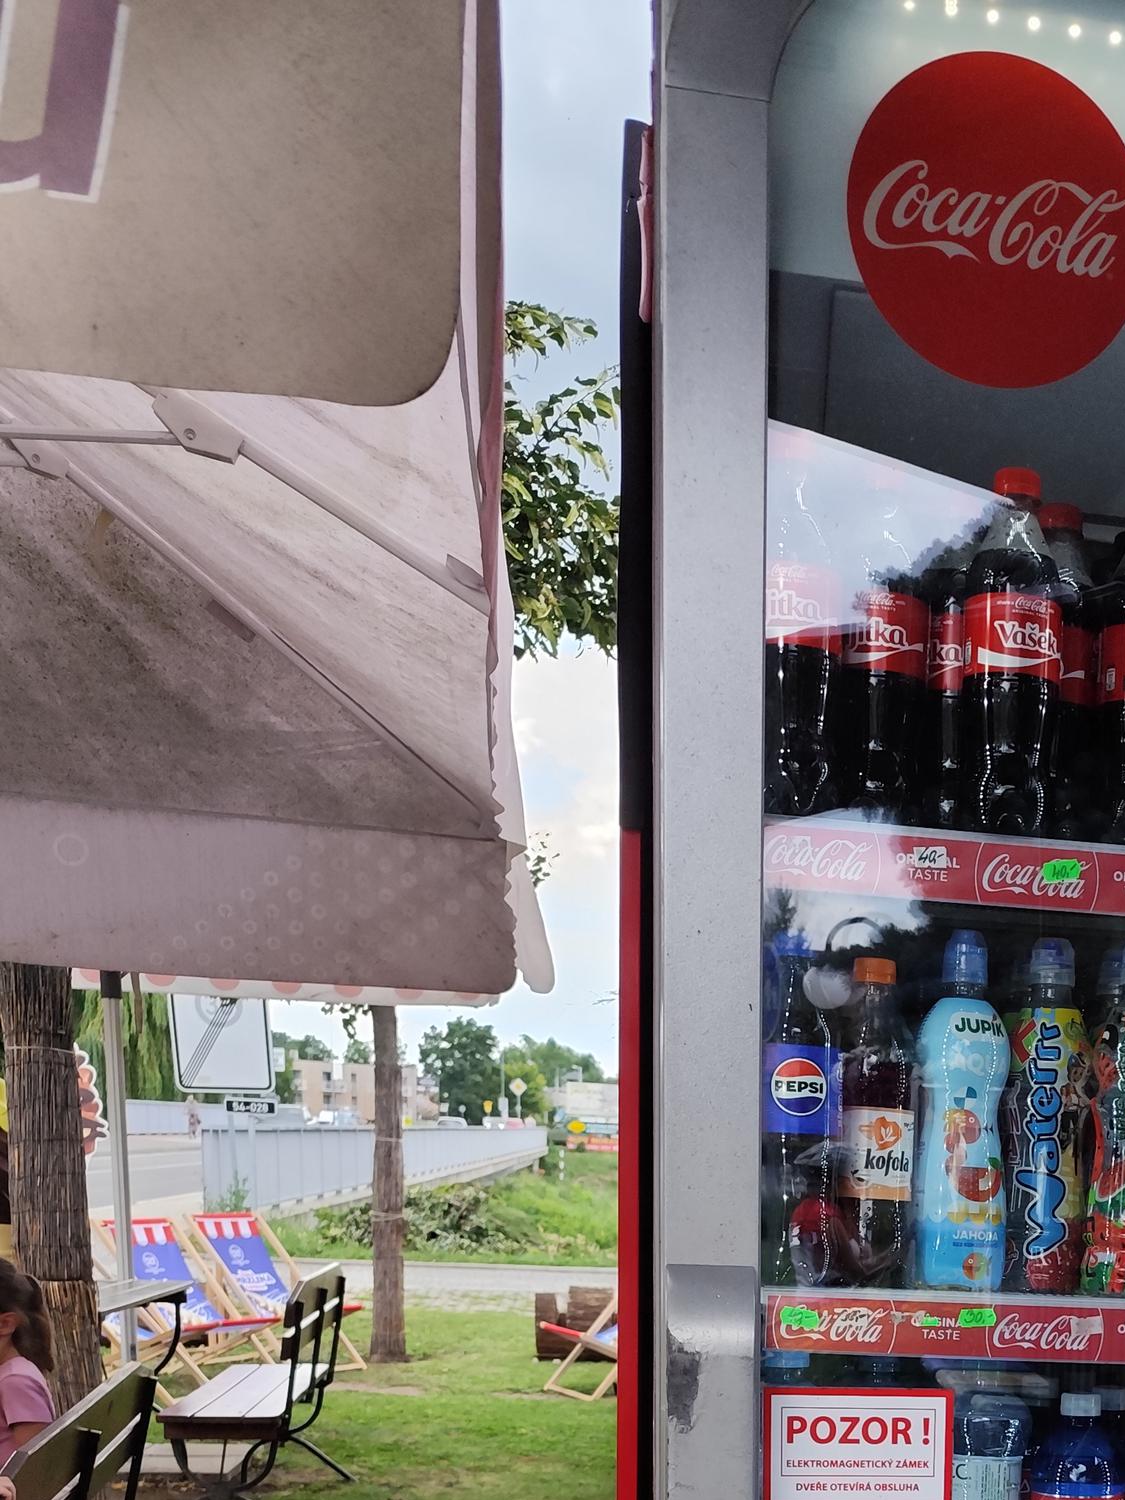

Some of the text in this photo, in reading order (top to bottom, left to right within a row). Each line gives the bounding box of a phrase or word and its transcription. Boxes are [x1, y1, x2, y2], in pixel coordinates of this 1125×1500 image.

[766, 587, 821, 620] itka
[993, 620, 1060, 656] Vašek
[896, 852, 961, 869] ORAL
[908, 868, 949, 882] TASTE
[774, 1079, 824, 1094] PEPSI
[864, 1149, 909, 1177] kofola
[952, 1229, 999, 1243] JAHODA
[921, 1328, 961, 1341] TASTE
[786, 1415, 931, 1445] POZOR !
[786, 1457, 929, 1469] ELEKTROMAGNETICKÝ ZÁMEK
[796, 1480, 919, 1492] DVEŘE OTEVÍRÁ OBSLUHA
